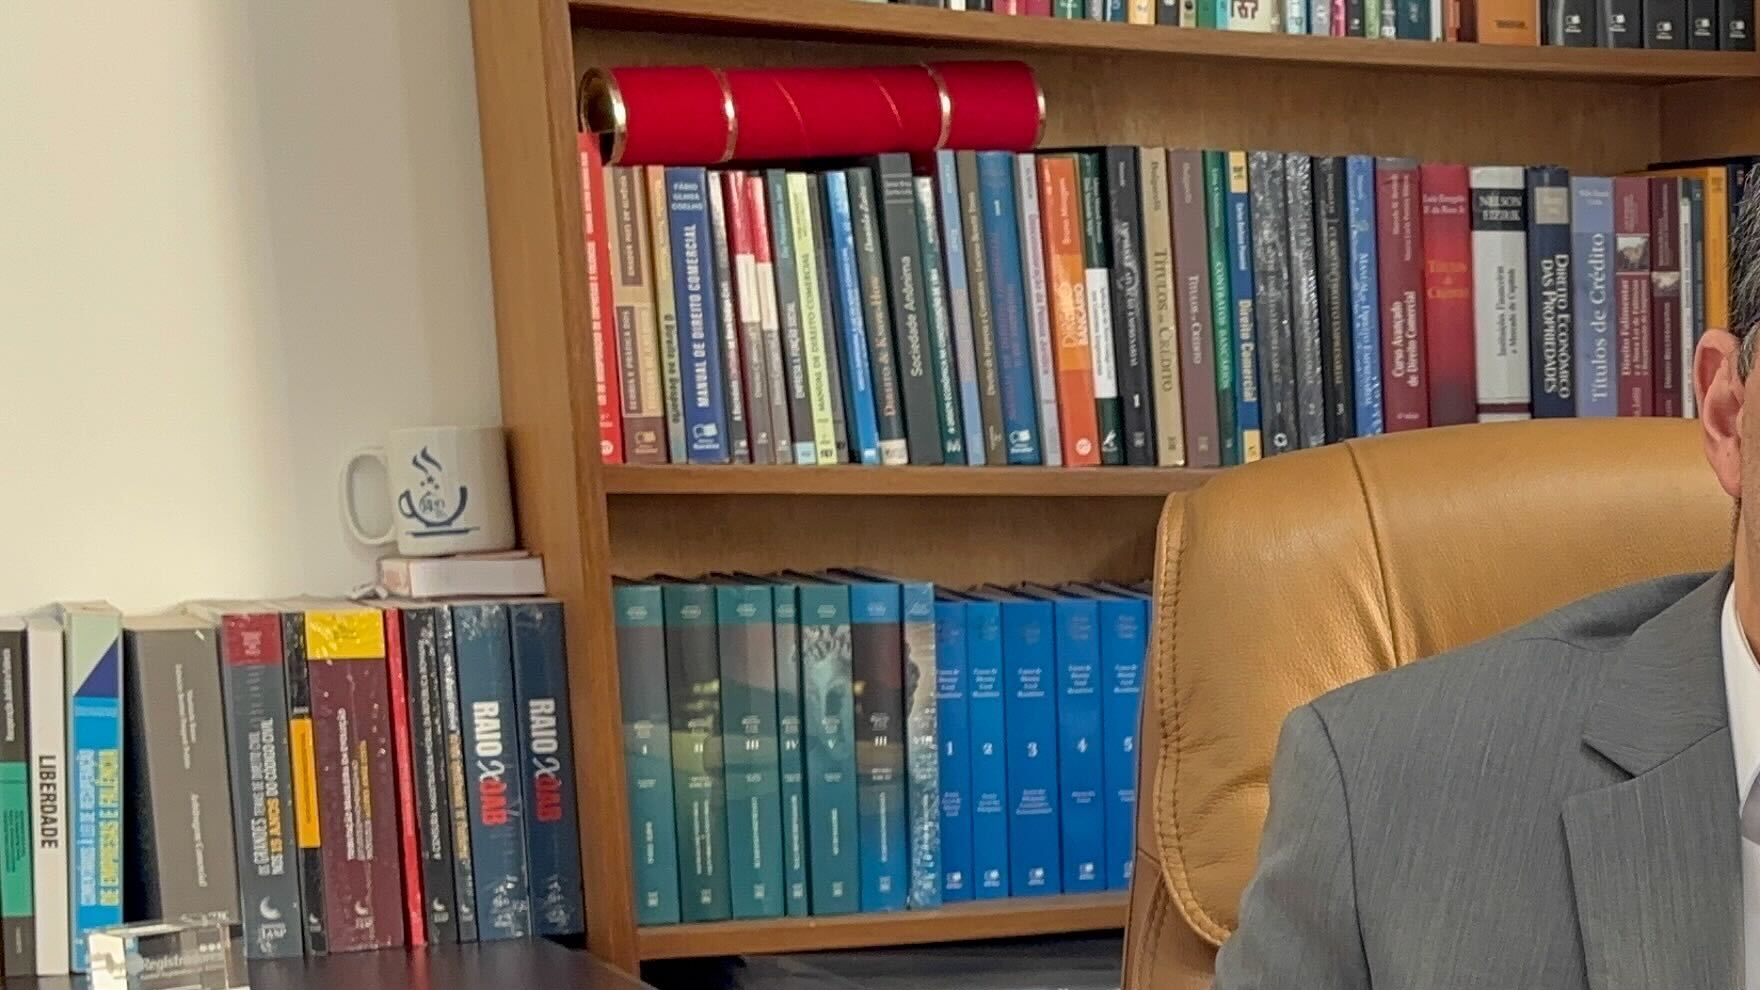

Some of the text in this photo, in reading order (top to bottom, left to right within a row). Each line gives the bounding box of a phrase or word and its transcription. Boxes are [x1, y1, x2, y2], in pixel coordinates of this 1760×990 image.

[1478, 194, 1522, 207] NELSON
[802, 254, 814, 310] COMERCIAL
[684, 224, 710, 408] MANUAL DE DIREITO COMERCIAL
[808, 312, 819, 352] DIREITO
[901, 256, 924, 376] Sociedade Anônima
[1390, 302, 1405, 378] Curso Avançado
[1404, 291, 1419, 387] de Direito Comercial
[1542, 260, 1558, 394] DAS PROPRIEDADES
[1554, 254, 1571, 399] DIREITO ECONÔMICO
[1588, 233, 1608, 400] Títulos de Crédito
[1238, 300, 1256, 402] Direito Comercial
[812, 372, 825, 412] MANUAL
[472, 700, 502, 758] RAIO
[529, 698, 558, 754] RAIO
[746, 738, 760, 750] III
[786, 738, 799, 750] IV
[946, 740, 953, 756] 1
[982, 742, 993, 756] 2
[1028, 741, 1038, 758] 3
[1078, 738, 1088, 753] 4
[1124, 736, 1133, 752] 5
[39, 755, 58, 848] LIBERDADE
